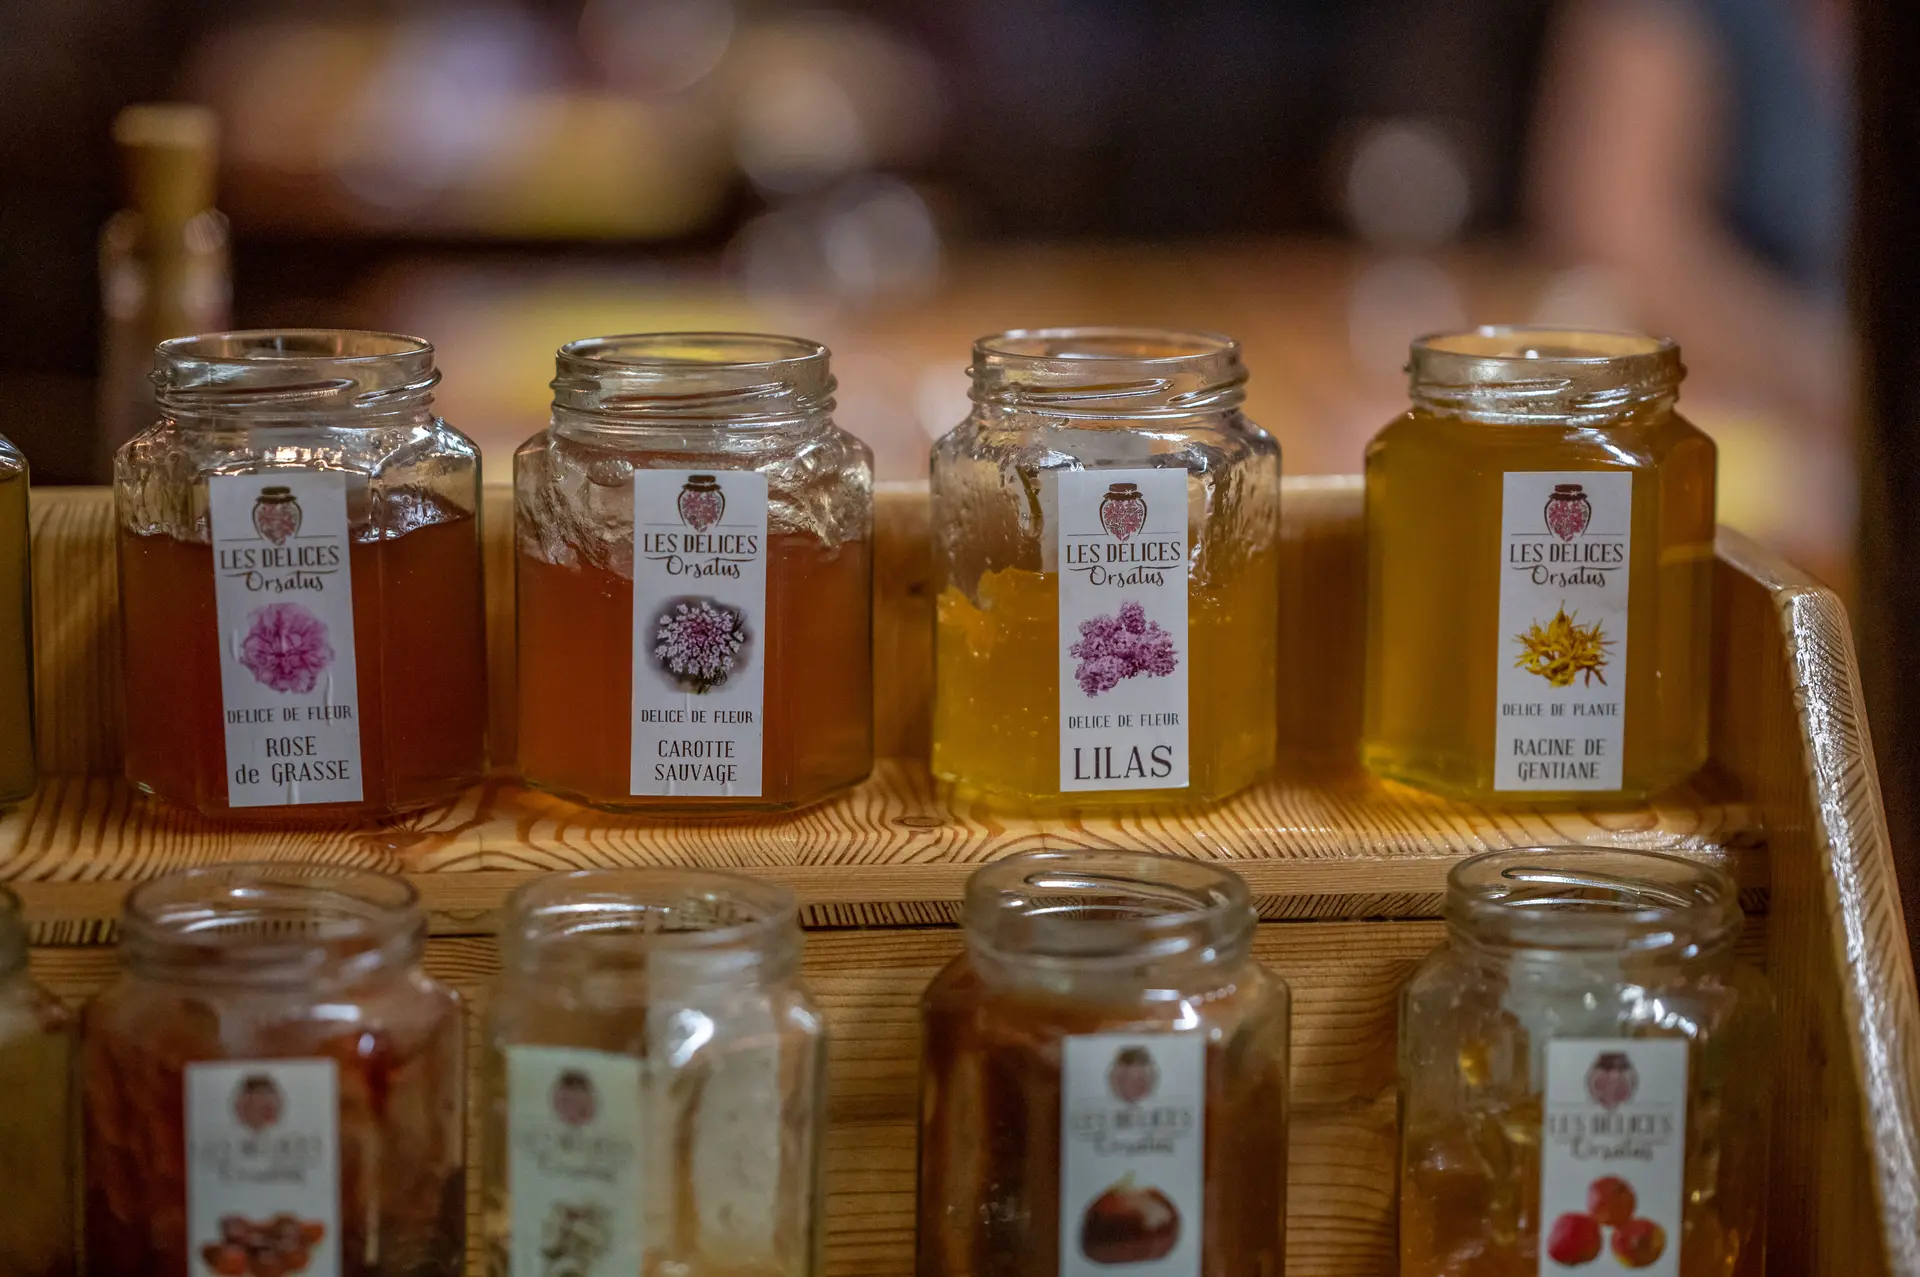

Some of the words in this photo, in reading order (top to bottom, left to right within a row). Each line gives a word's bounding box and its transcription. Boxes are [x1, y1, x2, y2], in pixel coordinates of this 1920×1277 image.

[643, 533, 678, 553] LES
[683, 534, 758, 555] DELICES
[1066, 543, 1100, 564] LES
[1106, 541, 1181, 563] DELICES
[1510, 543, 1544, 563] LES
[1549, 543, 1624, 563] DELICES
[220, 549, 256, 570] LES
[262, 545, 340, 568] DELICES
[666, 555, 741, 579] Orsatus
[1089, 565, 1164, 588] Orsatus
[1531, 564, 1606, 588] Orsatus
[227, 708, 275, 724] DELICE
[283, 707, 301, 722] DE
[307, 705, 353, 721] FLEUR
[641, 709, 685, 723] DELICE
[691, 710, 707, 723] DE
[714, 710, 754, 724] FLEUR
[1068, 715, 1112, 730] DELICE
[1118, 714, 1134, 728] DE
[1140, 712, 1180, 727] FLEUR
[1502, 703, 1544, 717] DELICE
[1550, 703, 1566, 717] DE
[1573, 703, 1620, 717] PLANTE
[265, 735, 318, 758] ROSE
[658, 739, 735, 758] CAROTTE
[1512, 738, 1576, 757] RACINE
[1583, 738, 1607, 756] DE
[1073, 744, 1173, 780] LILAS
[1517, 761, 1601, 783] GENTIANE
[235, 764, 260, 786] de
[271, 760, 351, 787] GRASSE
[654, 763, 738, 786] SAUVAGE
